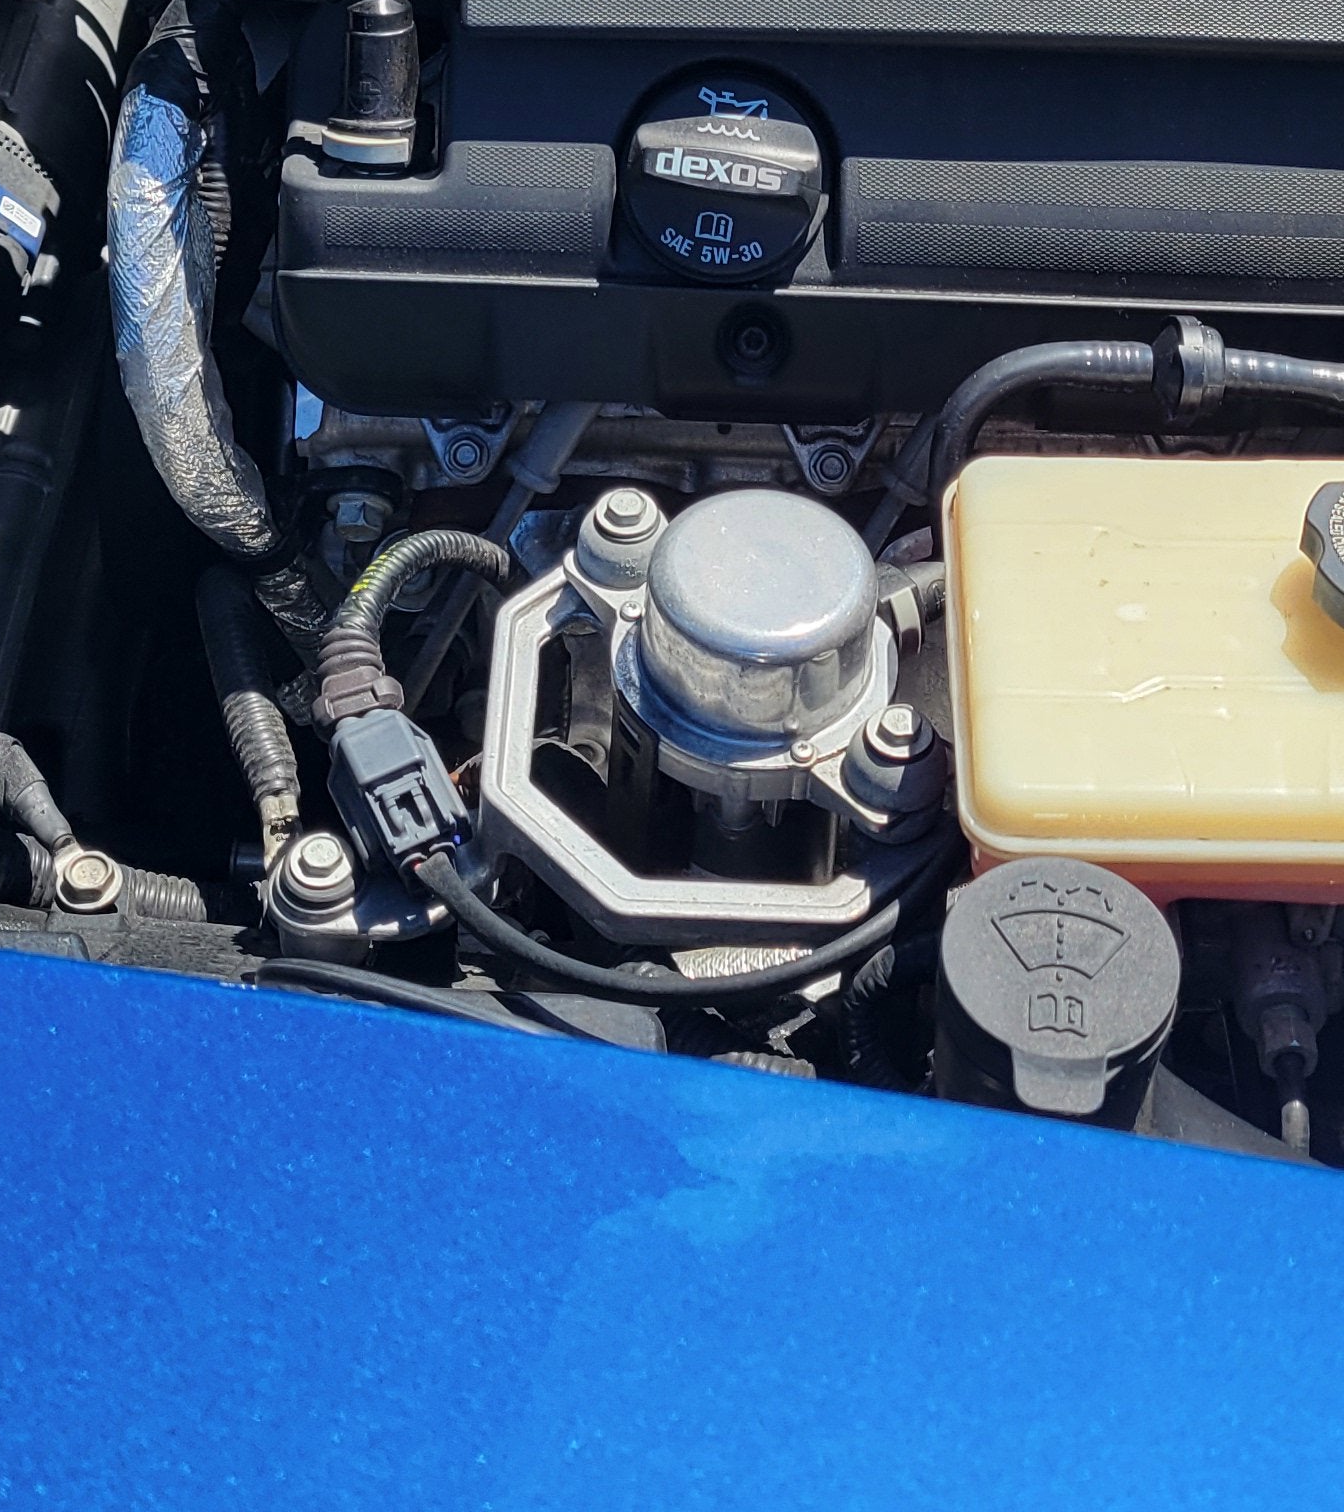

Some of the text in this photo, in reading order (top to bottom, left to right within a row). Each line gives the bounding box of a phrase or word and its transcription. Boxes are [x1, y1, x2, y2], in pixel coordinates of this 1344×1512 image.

[655, 147, 782, 190] dexos
[660, 228, 763, 265] SAE 5W-30
